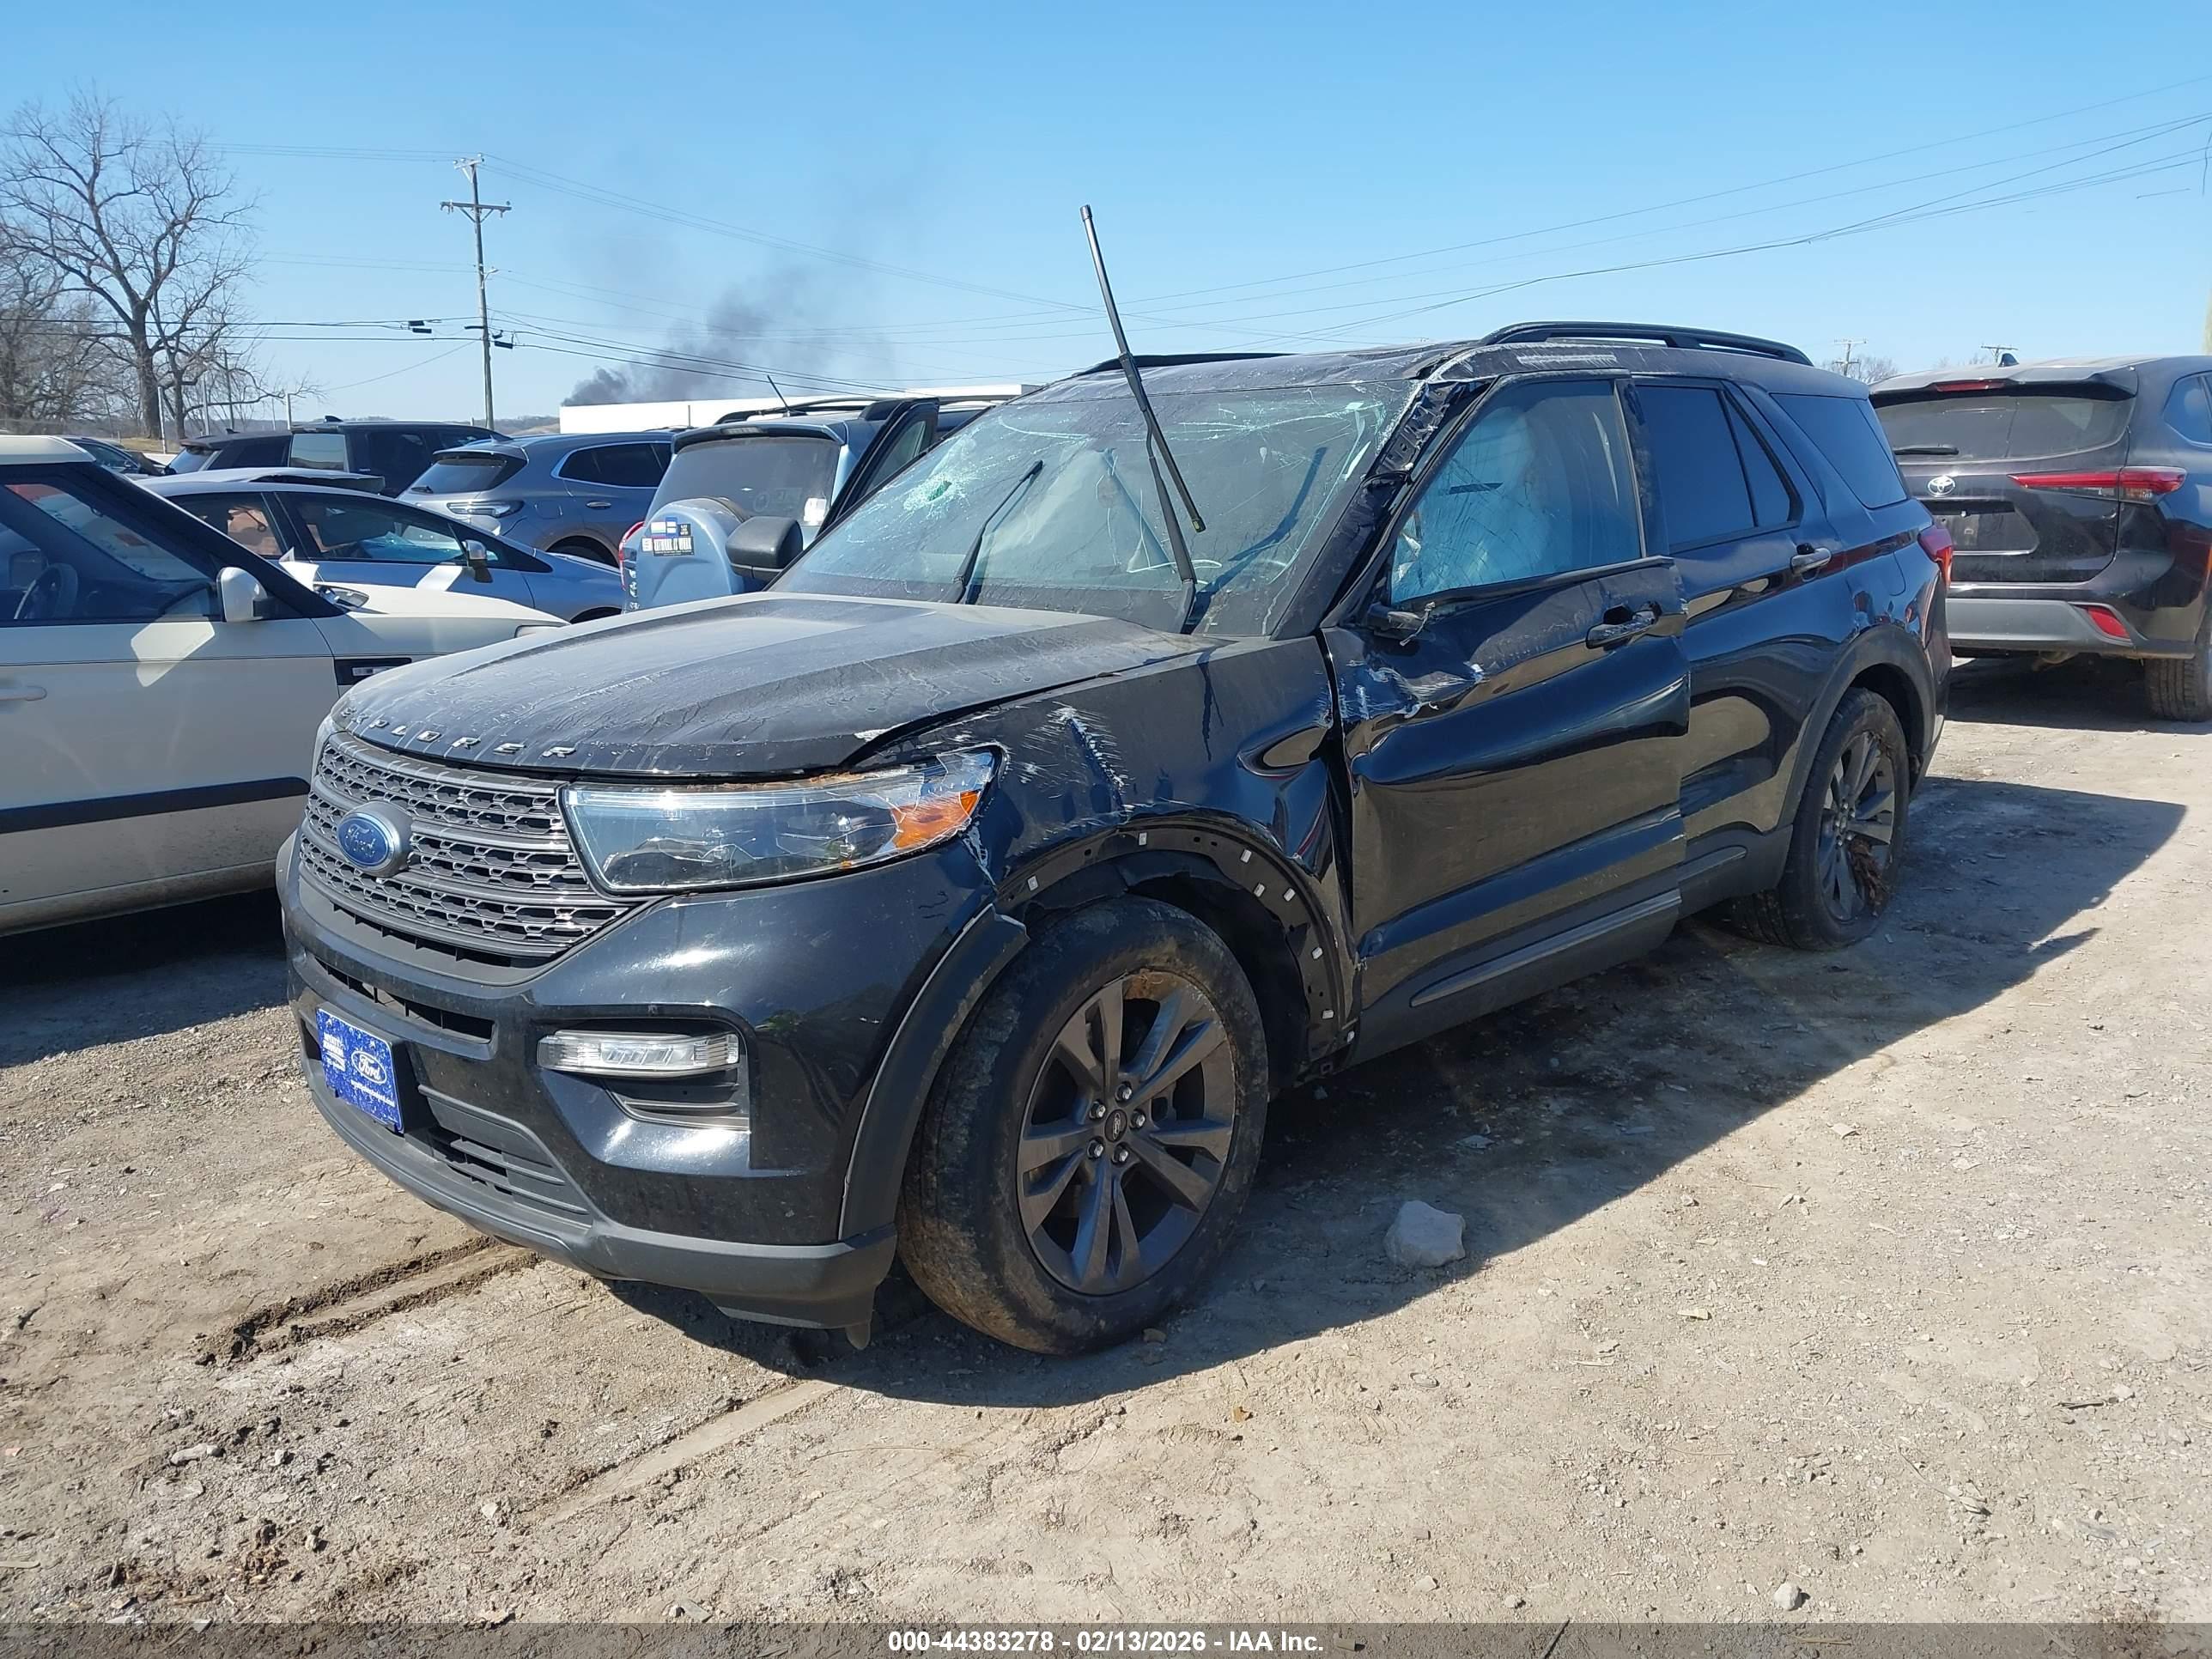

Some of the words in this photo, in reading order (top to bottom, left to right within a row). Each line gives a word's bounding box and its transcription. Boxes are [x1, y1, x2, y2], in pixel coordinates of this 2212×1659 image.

[340, 706, 578, 759] EXPLORER
[345, 823, 376, 858] Ford
[358, 1053, 381, 1081] Ford
